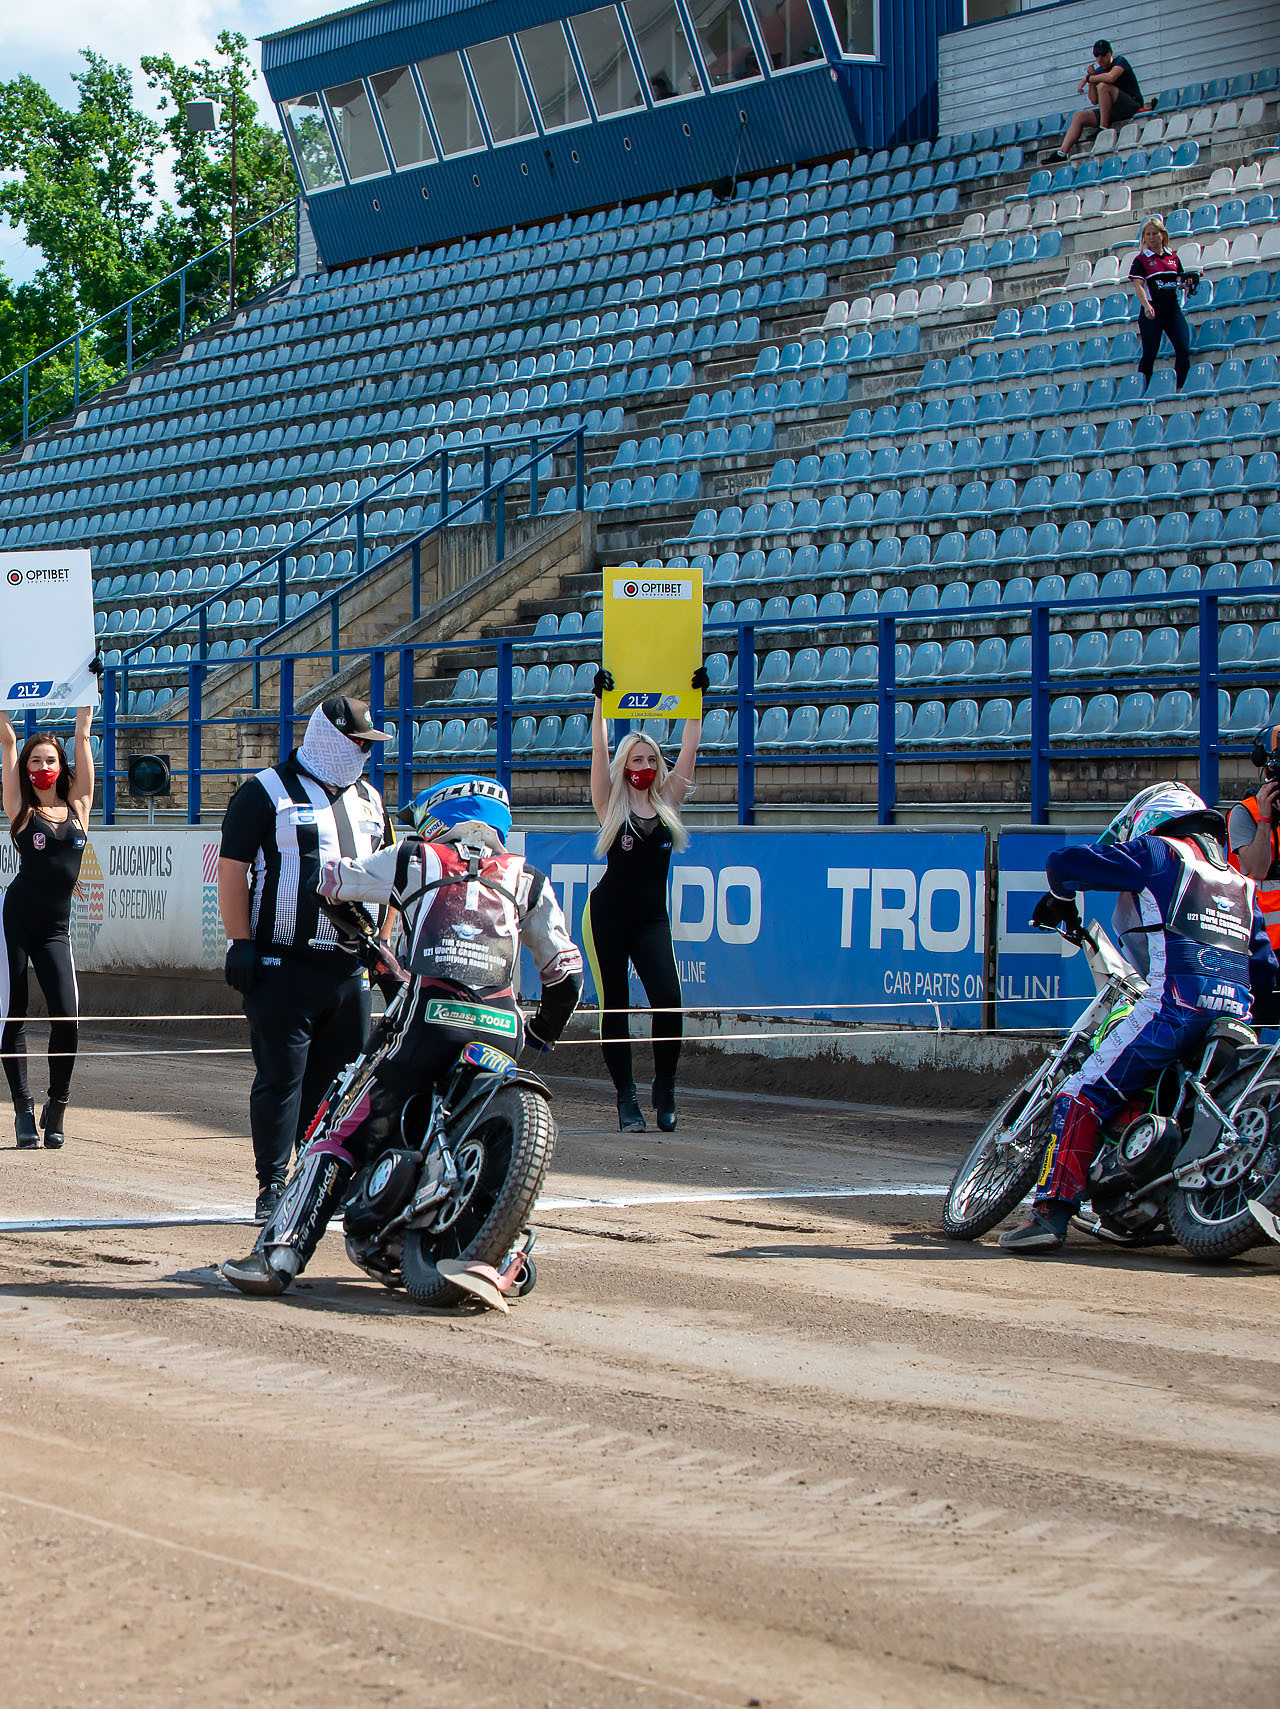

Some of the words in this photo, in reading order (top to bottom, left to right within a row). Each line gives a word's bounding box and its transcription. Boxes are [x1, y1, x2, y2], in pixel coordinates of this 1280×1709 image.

[26, 568, 70, 581] OPTIBET
[641, 583, 682, 594] OPTIBET
[17, 682, 41, 698] 2LŻ
[628, 693, 649, 708] 2LŻ
[109, 845, 173, 877] DAUGAVPILS
[108, 888, 117, 919] IS
[119, 889, 168, 921] SPEEDWAY
[1187, 912, 1199, 921] U21
[442, 938, 455, 947] FIM
[456, 939, 490, 953] Speedway
[423, 948, 434, 957] U21
[434, 946, 458, 955] World
[458, 947, 507, 967] Championship
[884, 970, 911, 995] CAR
[915, 972, 960, 997] PARTS
[1212, 984, 1236, 999] JAN
